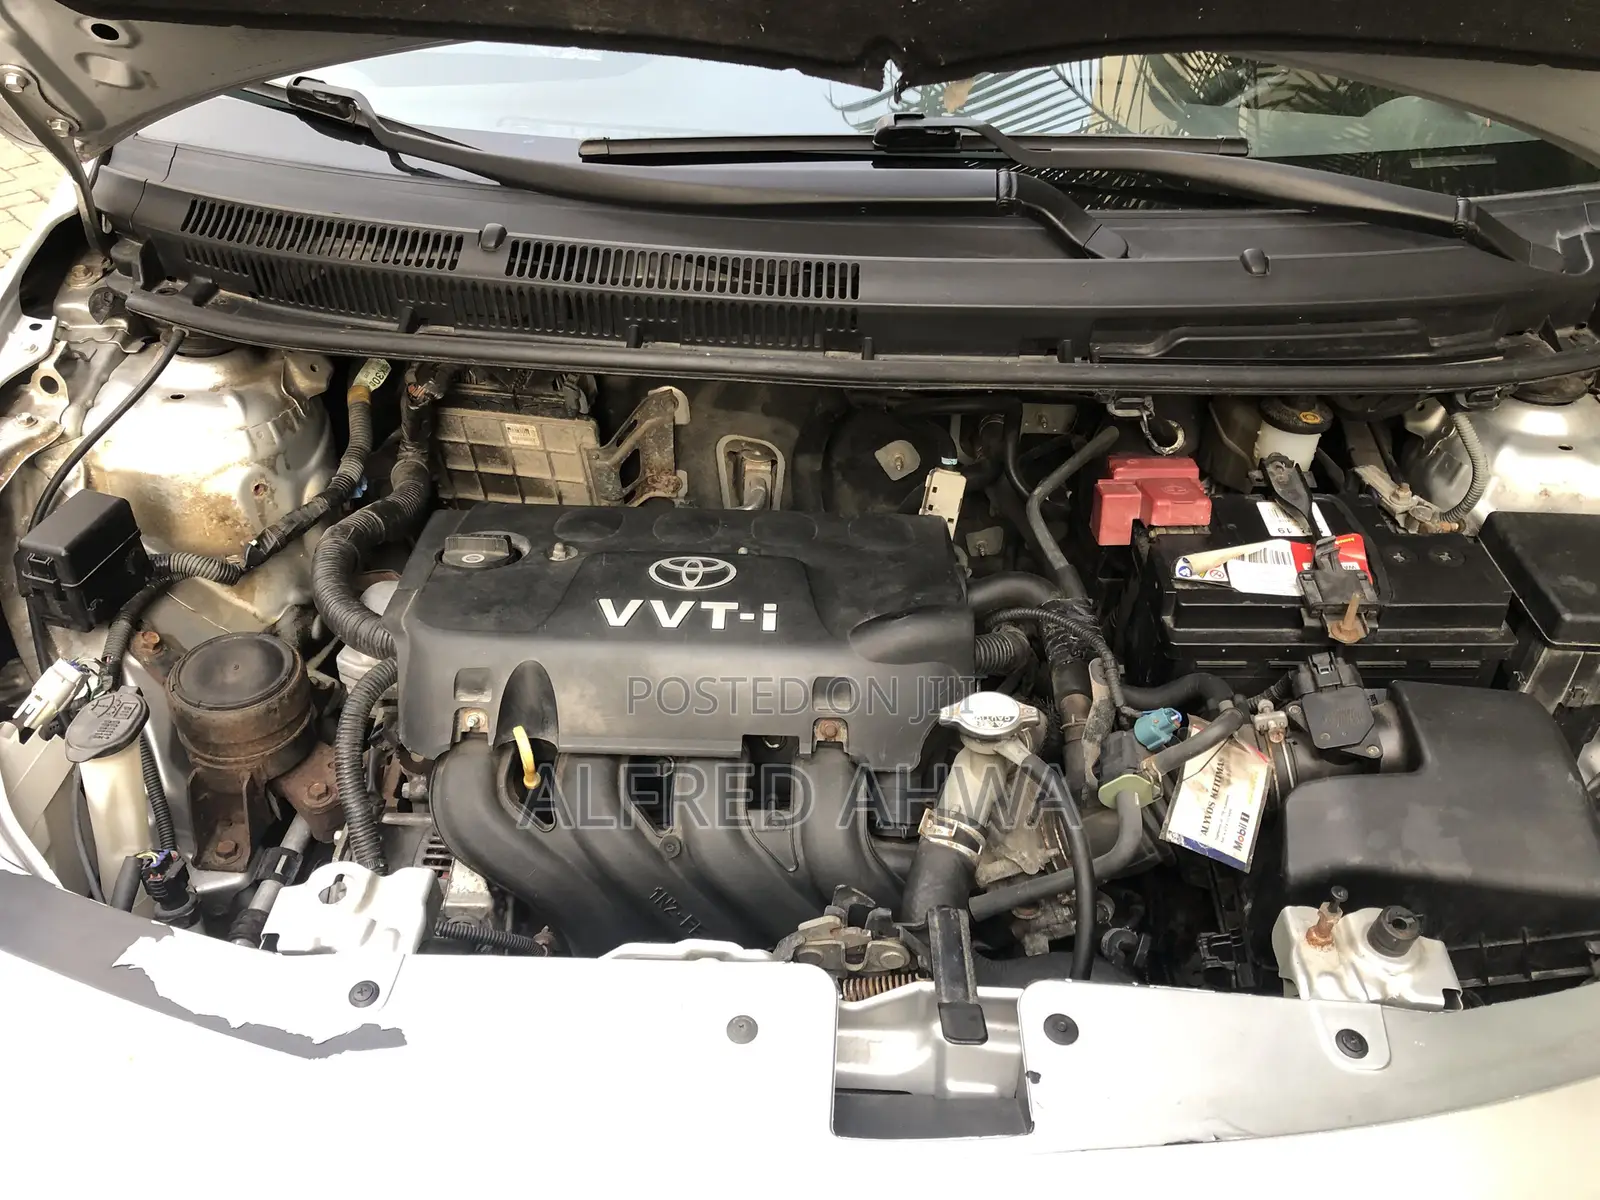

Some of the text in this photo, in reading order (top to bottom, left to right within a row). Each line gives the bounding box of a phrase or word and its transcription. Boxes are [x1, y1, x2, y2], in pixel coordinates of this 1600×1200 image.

[597, 598, 778, 632] VVT-i
[1200, 801, 1216, 836] ALYVOS
[1233, 822, 1249, 852] Mobil
